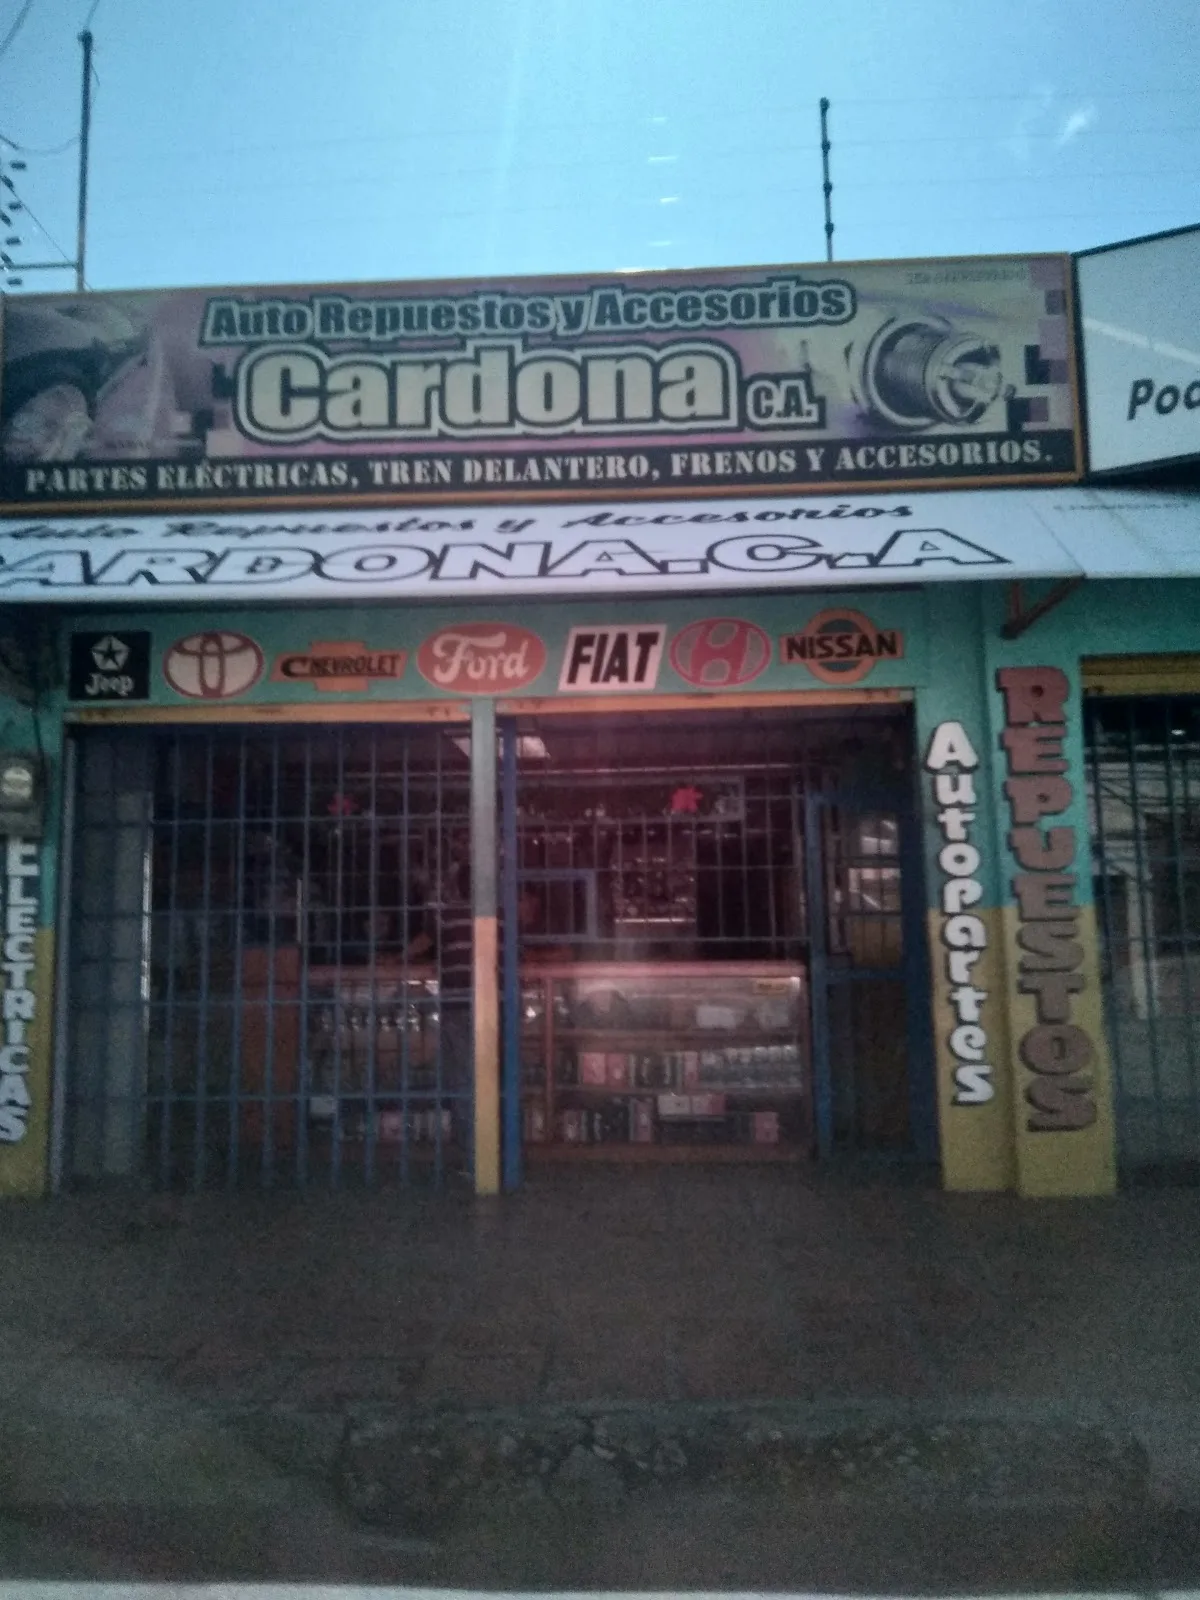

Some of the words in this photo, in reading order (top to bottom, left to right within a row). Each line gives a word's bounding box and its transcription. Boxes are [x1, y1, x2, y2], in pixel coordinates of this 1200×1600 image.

[205, 297, 312, 341] Auto
[314, 294, 556, 341] Repuestos
[559, 296, 588, 337] y
[590, 281, 854, 329] Accesorios
[243, 342, 730, 436] Cardona
[748, 379, 816, 422] C.A.
[25, 466, 148, 493] PARTES
[369, 459, 453, 485] TREN
[463, 455, 660, 484] DELANTERO,
[671, 450, 797, 477] FRENOS
[806, 448, 825, 471] Y
[835, 439, 1053, 471] ACCESORIOS.
[162, 516, 476, 539] Repuestos
[495, 518, 537, 533] y
[561, 503, 913, 528] Accesorios
[432, 631, 529, 683] Ford
[566, 630, 659, 684] FIAT
[786, 630, 898, 661] NISSAN
[997, 666, 1098, 1131] REPUESTOS
